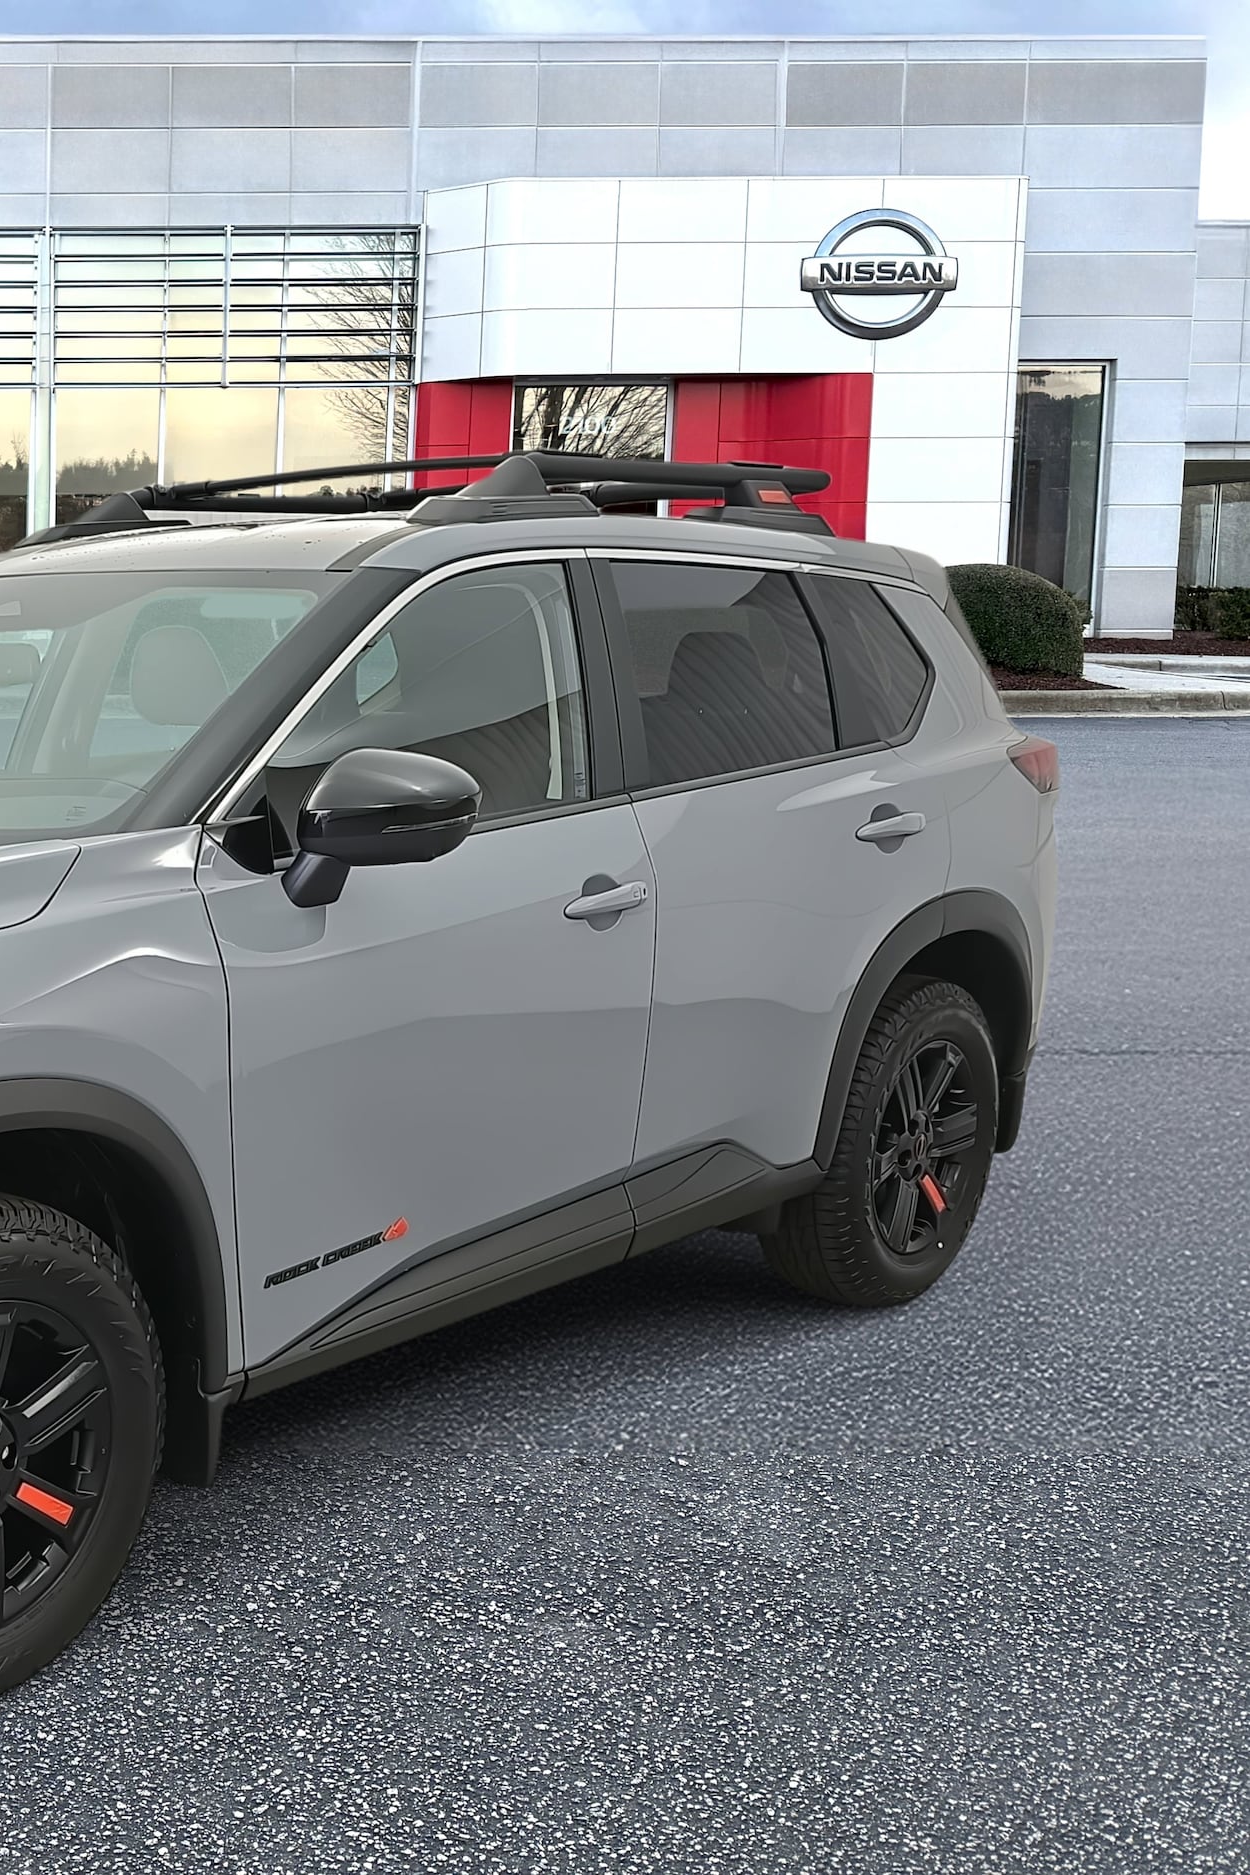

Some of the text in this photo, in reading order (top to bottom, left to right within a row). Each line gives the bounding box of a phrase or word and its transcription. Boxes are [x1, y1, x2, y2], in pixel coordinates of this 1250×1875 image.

[818, 261, 943, 283] NISSAN
[263, 1231, 384, 1289] ROCK CREEK
